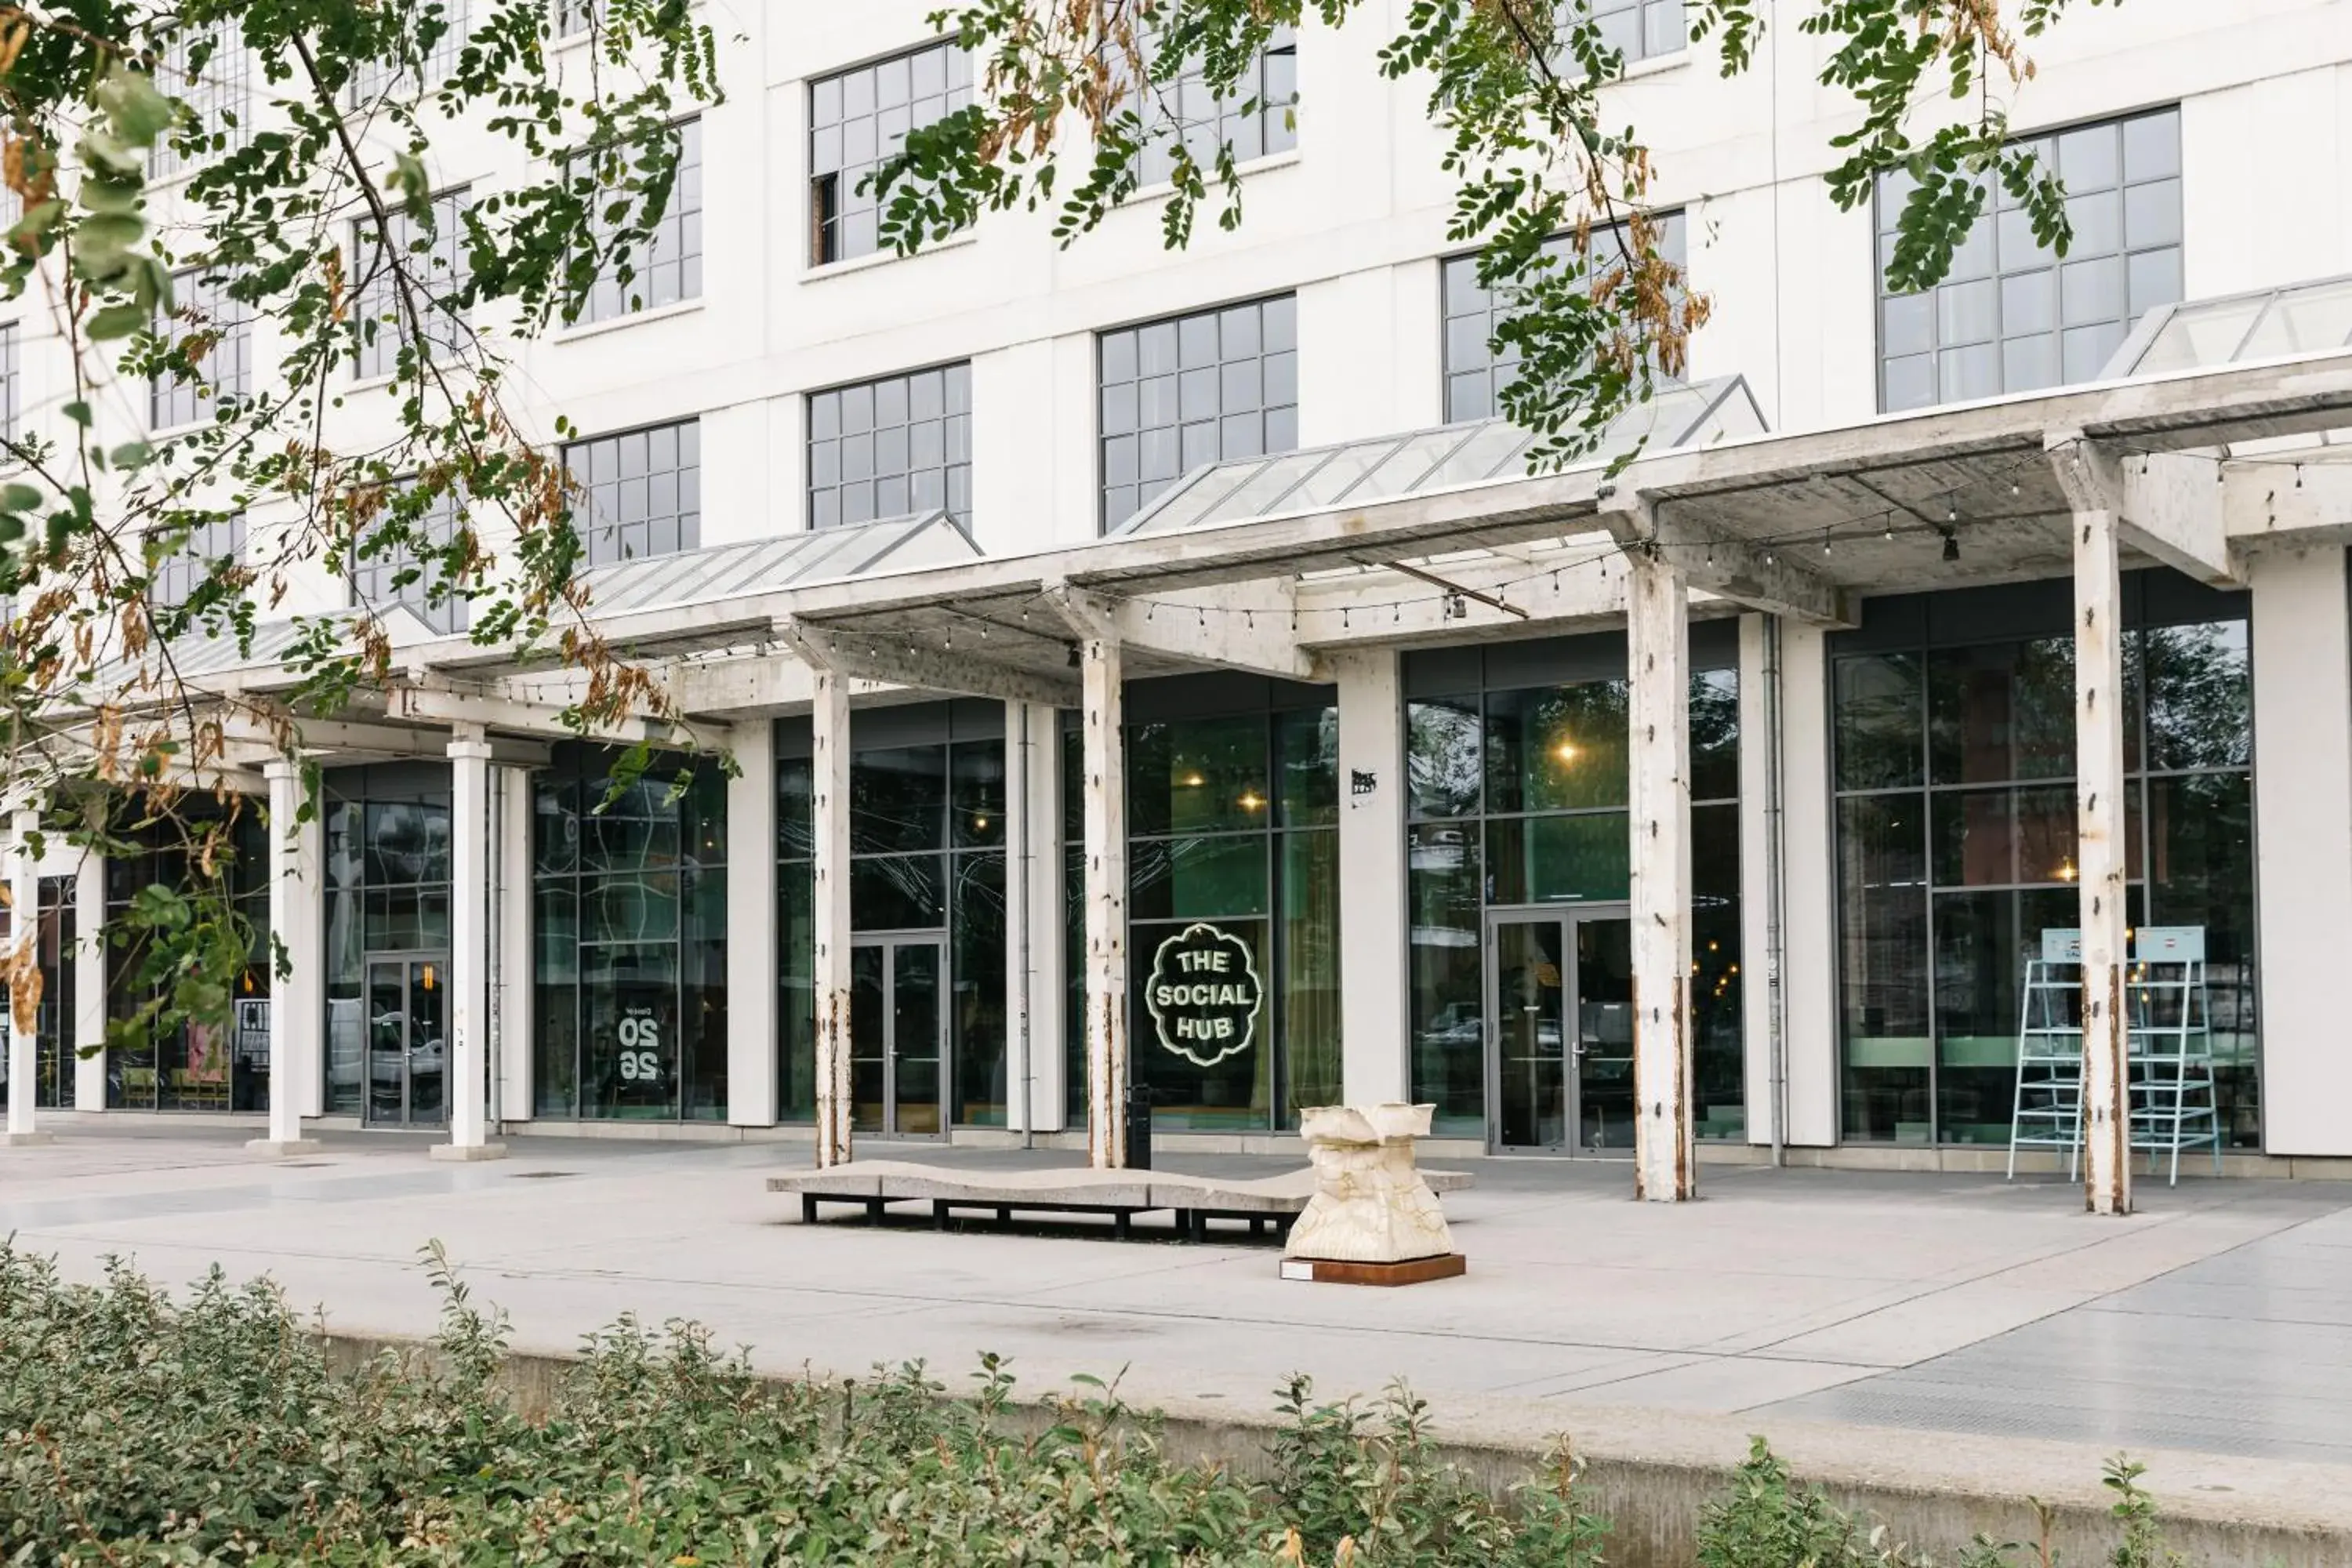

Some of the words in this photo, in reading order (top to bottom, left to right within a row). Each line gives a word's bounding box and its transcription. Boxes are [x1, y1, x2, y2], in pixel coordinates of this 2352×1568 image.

[1176, 950, 1231, 973] THE
[1156, 983, 1254, 1006] SOCIAL
[1177, 1017, 1234, 1040] HUB
